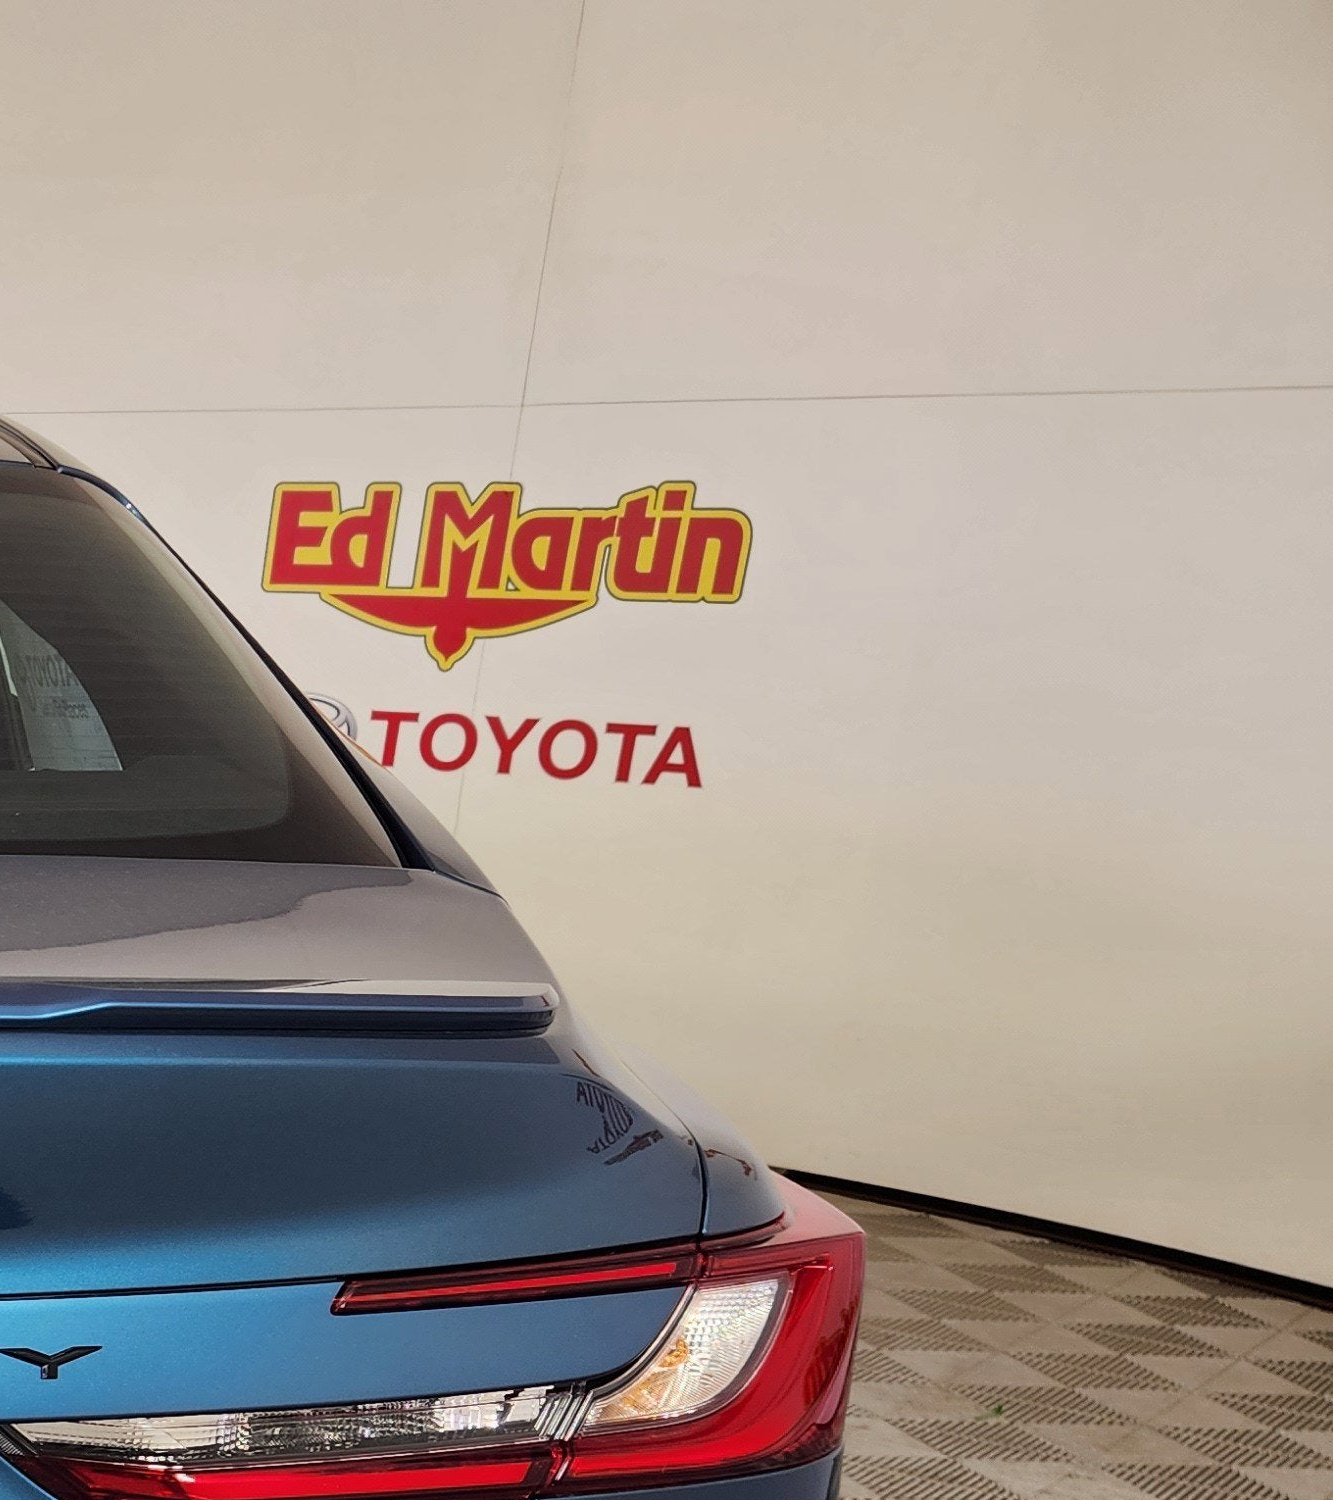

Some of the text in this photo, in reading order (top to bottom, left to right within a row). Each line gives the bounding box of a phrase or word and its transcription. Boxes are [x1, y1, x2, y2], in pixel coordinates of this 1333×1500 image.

[262, 481, 753, 603] Ed Martin
[371, 710, 703, 789] TOYOTA
